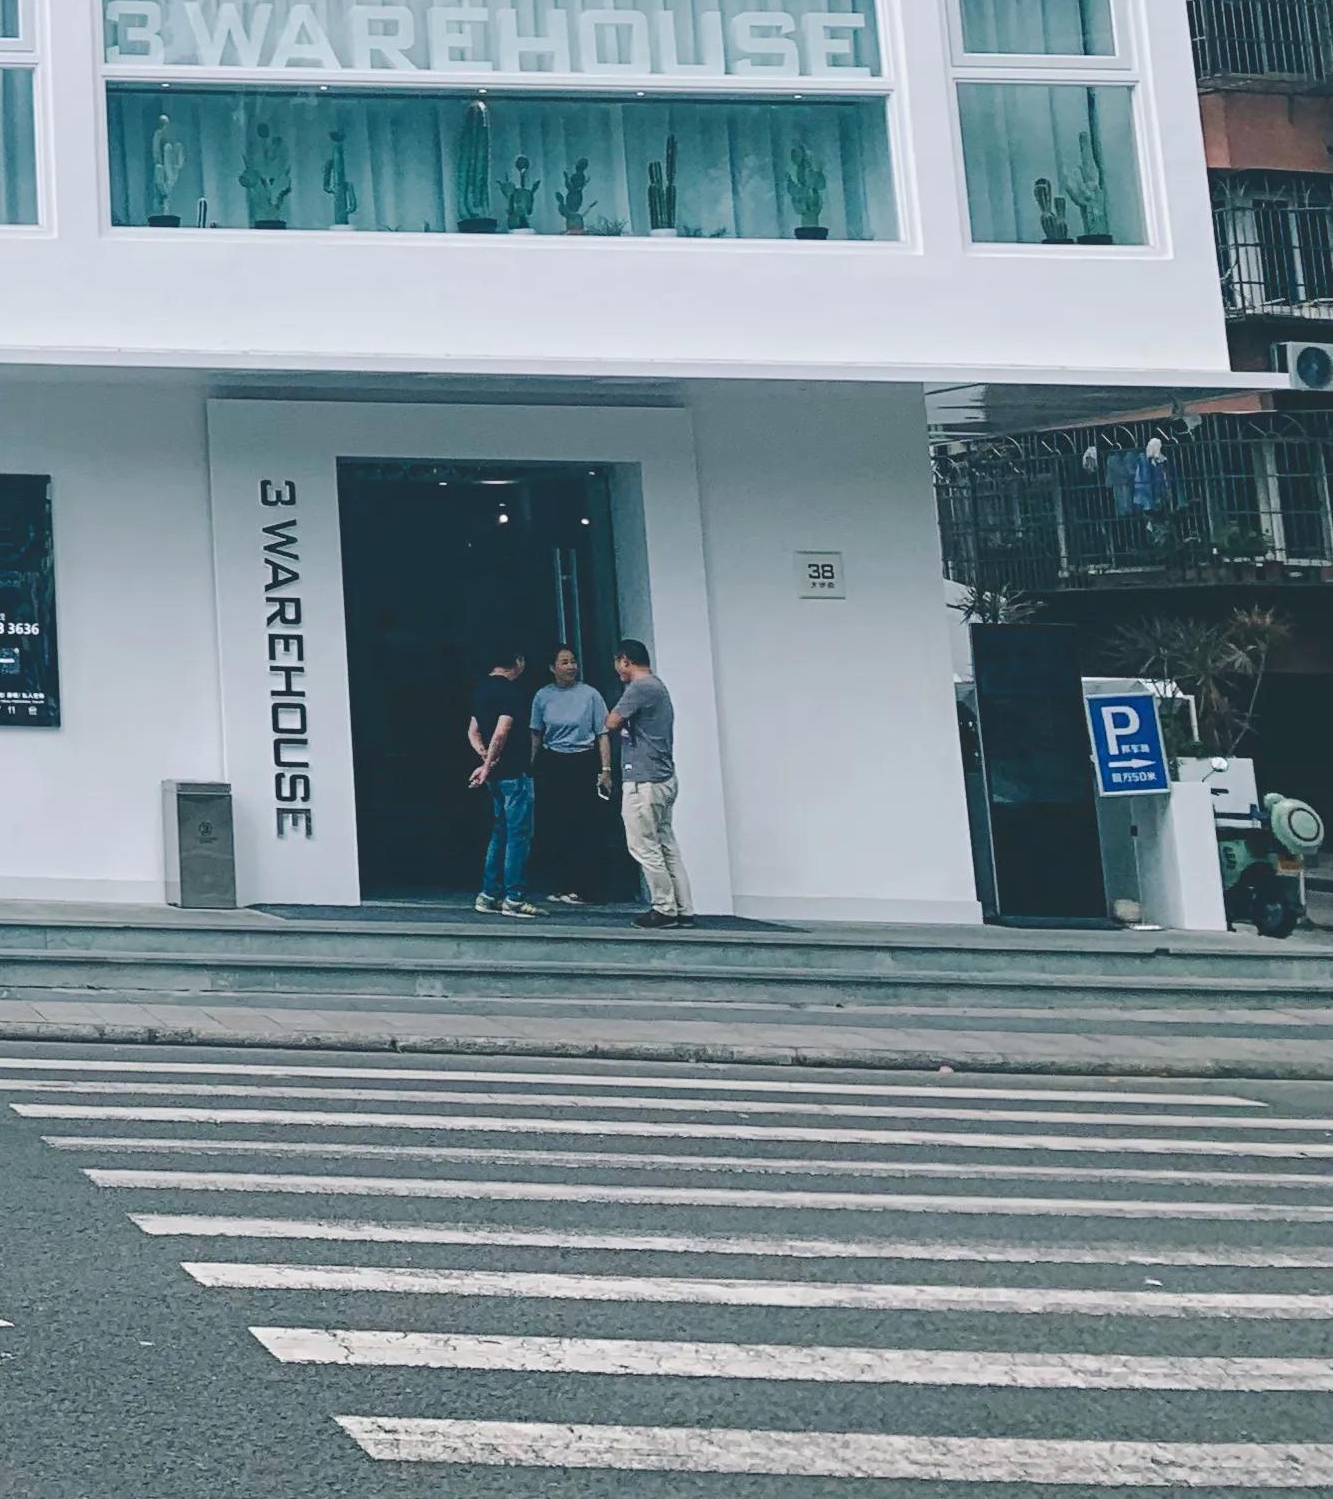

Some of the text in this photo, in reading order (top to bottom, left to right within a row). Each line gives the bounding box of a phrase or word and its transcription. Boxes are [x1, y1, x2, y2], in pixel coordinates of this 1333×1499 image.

[105, 0, 873, 78] 3 WAREHOUSE
[808, 563, 835, 580] 38
[7, 623, 40, 636] 3636
[259, 479, 313, 840] 3 WAREHOUSE
[1100, 705, 1141, 756] P
